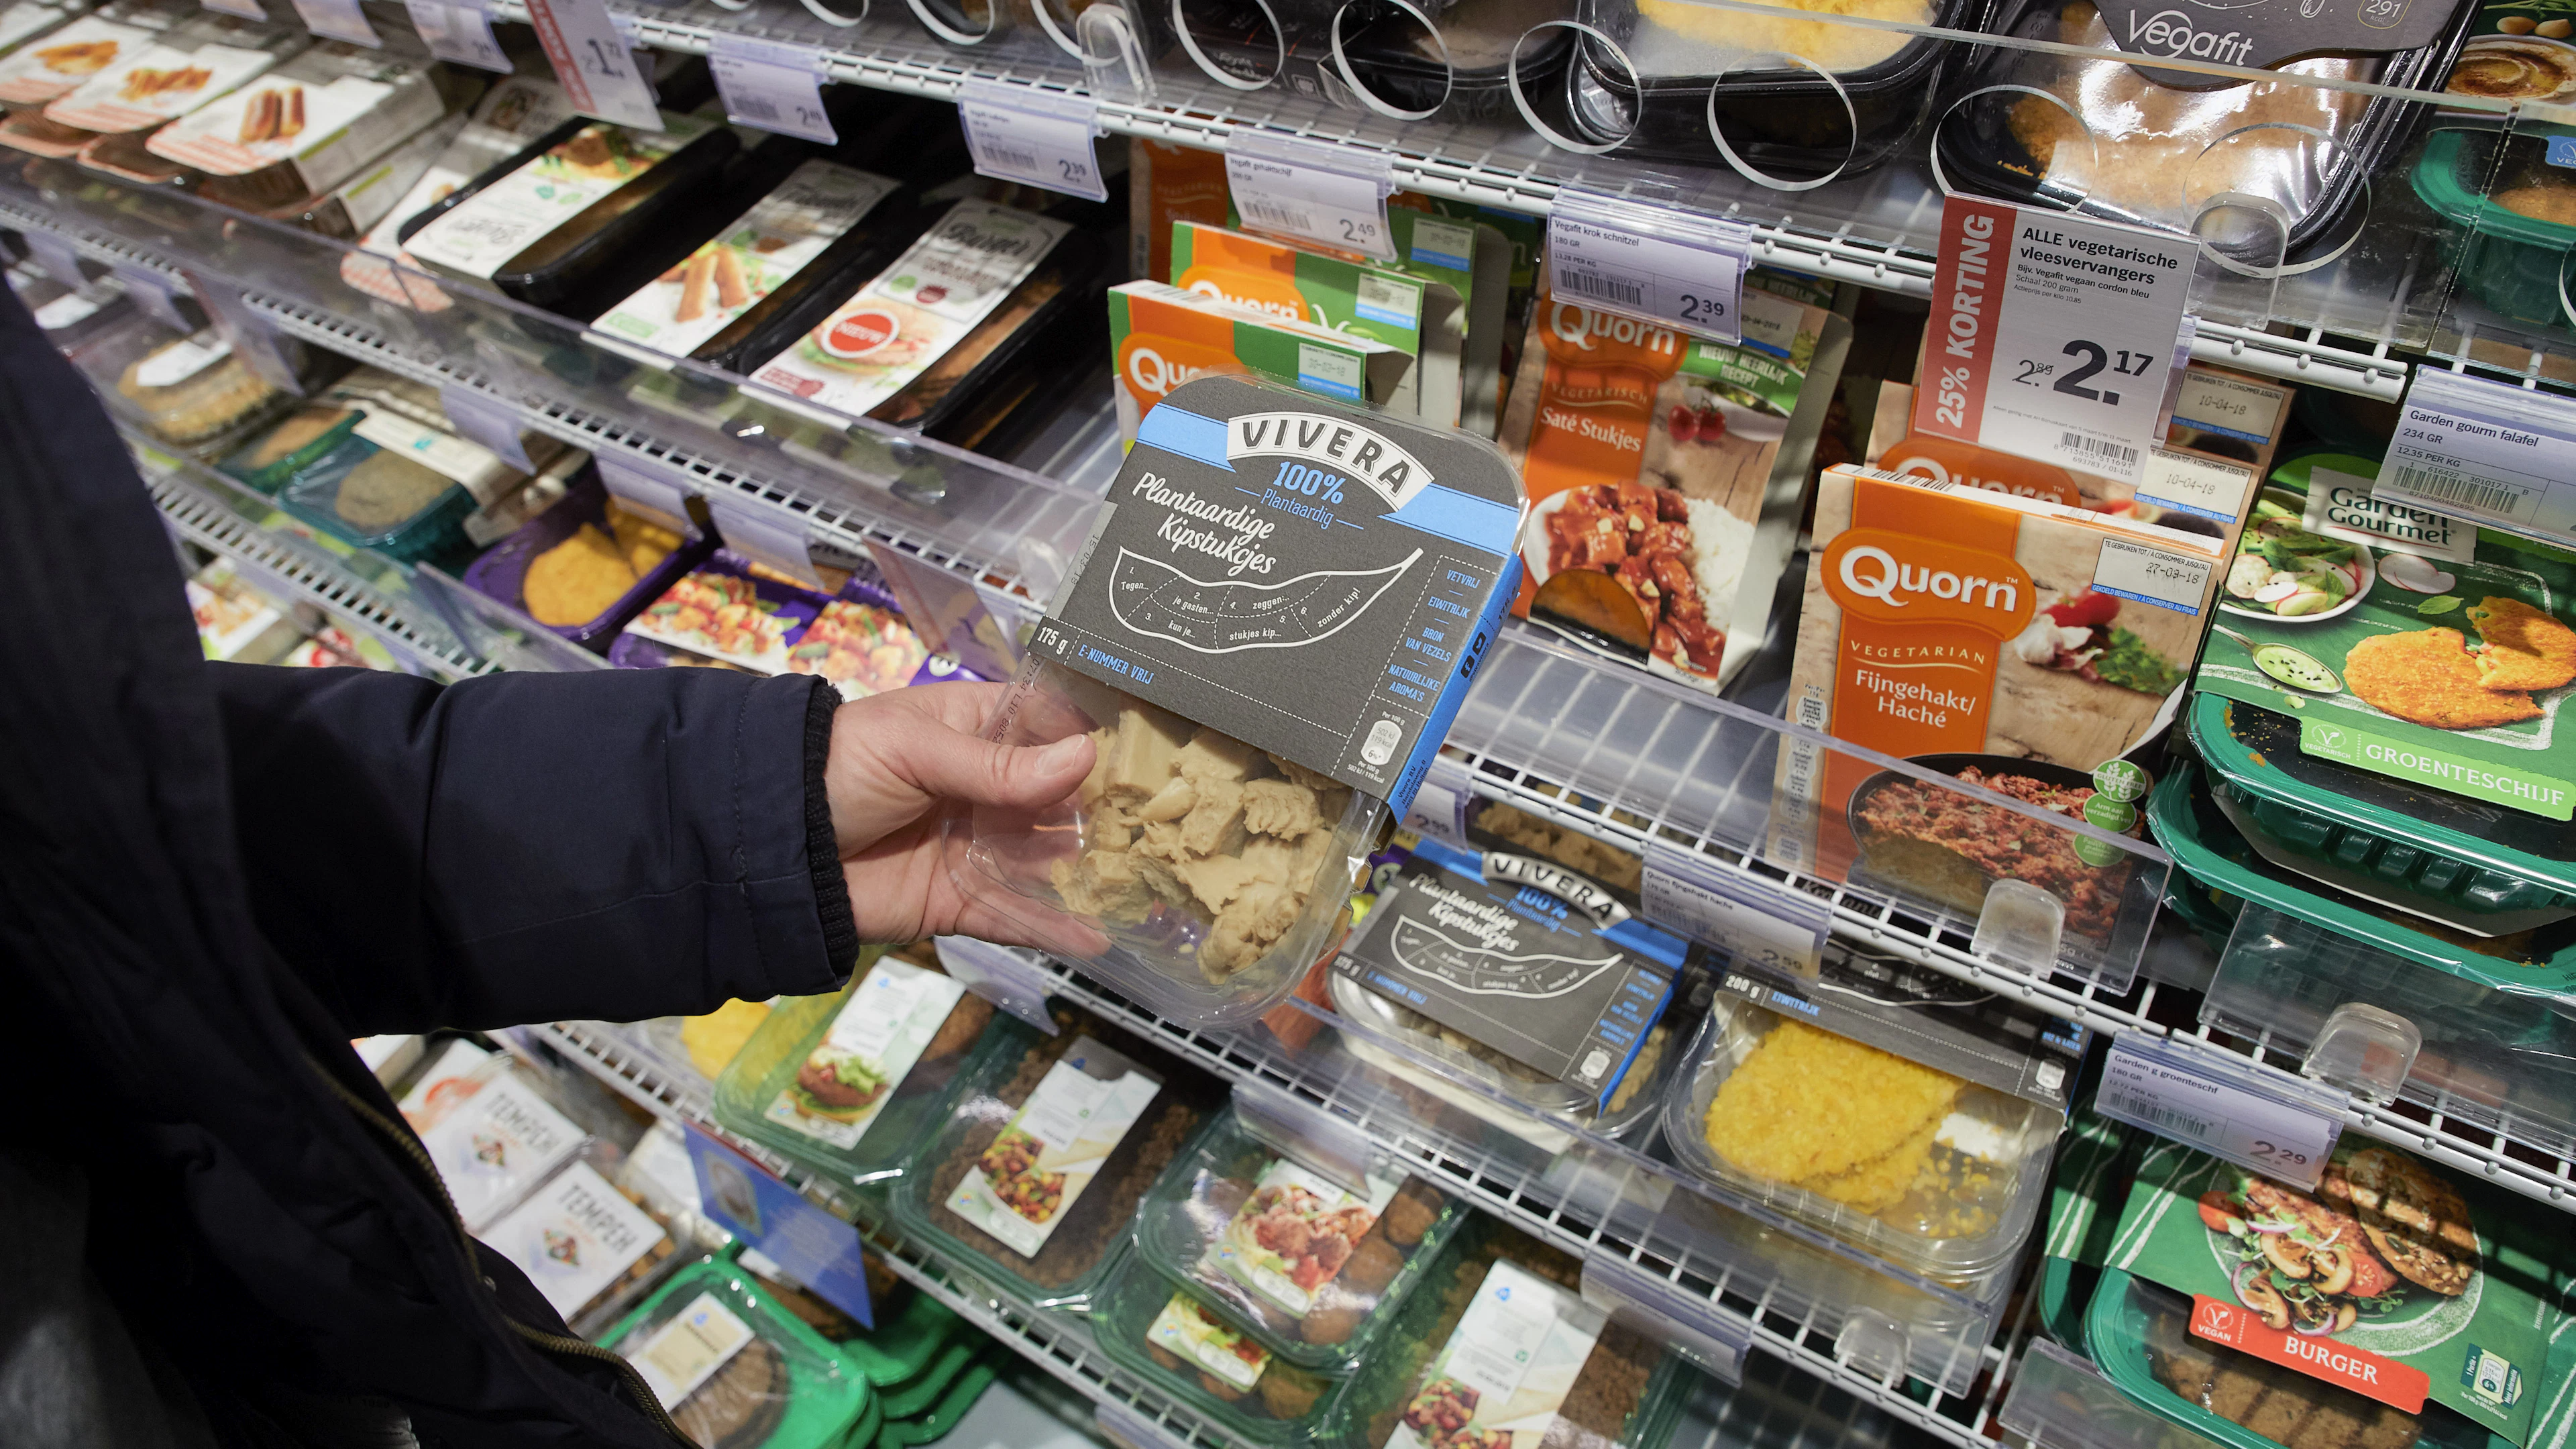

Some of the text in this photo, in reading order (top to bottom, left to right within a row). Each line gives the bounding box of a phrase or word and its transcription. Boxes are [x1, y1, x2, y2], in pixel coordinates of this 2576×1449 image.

[2365, 0, 2400, 17] 291
[2129, 9, 2253, 66] Vegafit
[1340, 219, 1375, 244] 2.49
[1554, 219, 1640, 247] Vegafit krok schnitzel
[1554, 236, 1580, 249] 180 GR
[2023, 227, 2178, 270] ALLE vegetarische
[1573, 257, 1585, 266] PER
[2020, 246, 2155, 285] vleesvervangers
[2016, 274, 2079, 294] Schaal 200 gram
[2017, 264, 2150, 299] Bijv. Vegafit vegaan cordon bleu
[2014, 284, 2082, 305] Actieprijs per kilo 10.85
[1680, 294, 1725, 324] 2.39
[1935, 214, 1994, 428] 25% KORTING
[1550, 303, 1676, 356] Quorn
[1699, 343, 1735, 368] NIEUW
[1720, 366, 1761, 389] RECEPT
[2012, 339, 2154, 406] 2.89 2.17
[1550, 382, 1649, 405] VEGETARISCH
[2199, 395, 2247, 415] 10-04-18
[1542, 406, 1642, 453] Saté Stukjes
[2008, 409, 2022, 417] geldig
[2041, 417, 2068, 428] Bonuskaart
[2410, 410, 2539, 447] Garden gourm falafel
[2403, 427, 2443, 445] 234 GR
[1242, 419, 1411, 498] VIVERA
[2073, 456, 2133, 477] 693783 01-116
[2157, 449, 2181, 464] GEBRUIKEN
[2197, 460, 2226, 474] CONSOMMER
[2397, 446, 2461, 468] 12.35 PER KG
[1272, 461, 1348, 505] 100%
[2166, 474, 2215, 495] 10-04-18
[2428, 466, 2502, 490] 616422 301017
[1133, 472, 1276, 545] Plantaardige
[1260, 489, 1334, 530] Plantaardig
[2408, 490, 2475, 512] 8710400482895
[2328, 507, 2452, 545] Gourmet
[1158, 513, 1277, 577] Kipstukjes
[2112, 542, 2138, 553] GEBRUIKEN
[2155, 552, 2185, 565] CONSOMMER
[2186, 559, 2208, 571] JUSQU'AU
[1446, 570, 1481, 589] VETVRIJ
[1839, 545, 2017, 612] Quorn
[2146, 562, 2200, 584] 27-03-18
[1121, 581, 1149, 591] Tegen...
[1194, 592, 1201, 600] 2.
[1172, 595, 1214, 616] je gasten...
[1230, 602, 1236, 610] 4.
[1300, 607, 1307, 616] 6.
[1317, 588, 1360, 628] zonder kip!
[1428, 596, 1470, 619] EIWITRIJK
[2092, 584, 2197, 615] GEKOELD BEWAREN CONSERVER FRAIS
[1145, 613, 1152, 621] 3.
[1169, 621, 1195, 638] kun je...
[1279, 615, 1286, 624] 5.
[1037, 627, 1069, 655] 175 g
[1230, 627, 1282, 641] stukjes kip...
[1422, 627, 1445, 643] BRON
[1405, 637, 1452, 662] VAN VEZELS
[1850, 640, 1984, 665] VEGETARIAN
[1078, 644, 1155, 685] E-NUMMER VRIJ
[1008, 658, 1040, 715] 07:34 L10
[1388, 664, 1441, 692] NATUURLIJKE
[1389, 682, 1425, 702] AROMA'S
[1856, 669, 1976, 716] Fijngehakt/
[1382, 711, 1401, 723] Per 100
[1878, 696, 1947, 728] Haché
[1371, 735, 1395, 749] 119 kcal
[1377, 727, 1395, 739] 502 kJ
[2304, 742, 2351, 760] VEGETARISCH
[1358, 760, 1375, 773] Per 100
[2365, 743, 2565, 807] GROENTESCHIJF
[1397, 778, 1411, 798] Vivera
[2097, 773, 2143, 790] GLUTEN FREE
[2086, 807, 2120, 821] verzadigd
[2095, 802, 2111, 810] Arm
[1409, 873, 1519, 931] Plantaardige
[1495, 859, 1613, 920] VIVERA
[1515, 885, 1568, 920] 100%
[1725, 975, 1761, 1000] 200 g
[2111, 1067, 2143, 1083] 180 GR
[2114, 1054, 2219, 1095] Garden g groenteschf
[485, 1091, 554, 1155] TEMPEH
[2250, 1140, 2307, 1166] 2.29
[557, 1181, 639, 1256] TEMPEH
[2198, 1324, 2231, 1342] VEGAN
[2284, 1336, 2378, 1385] BURGER
